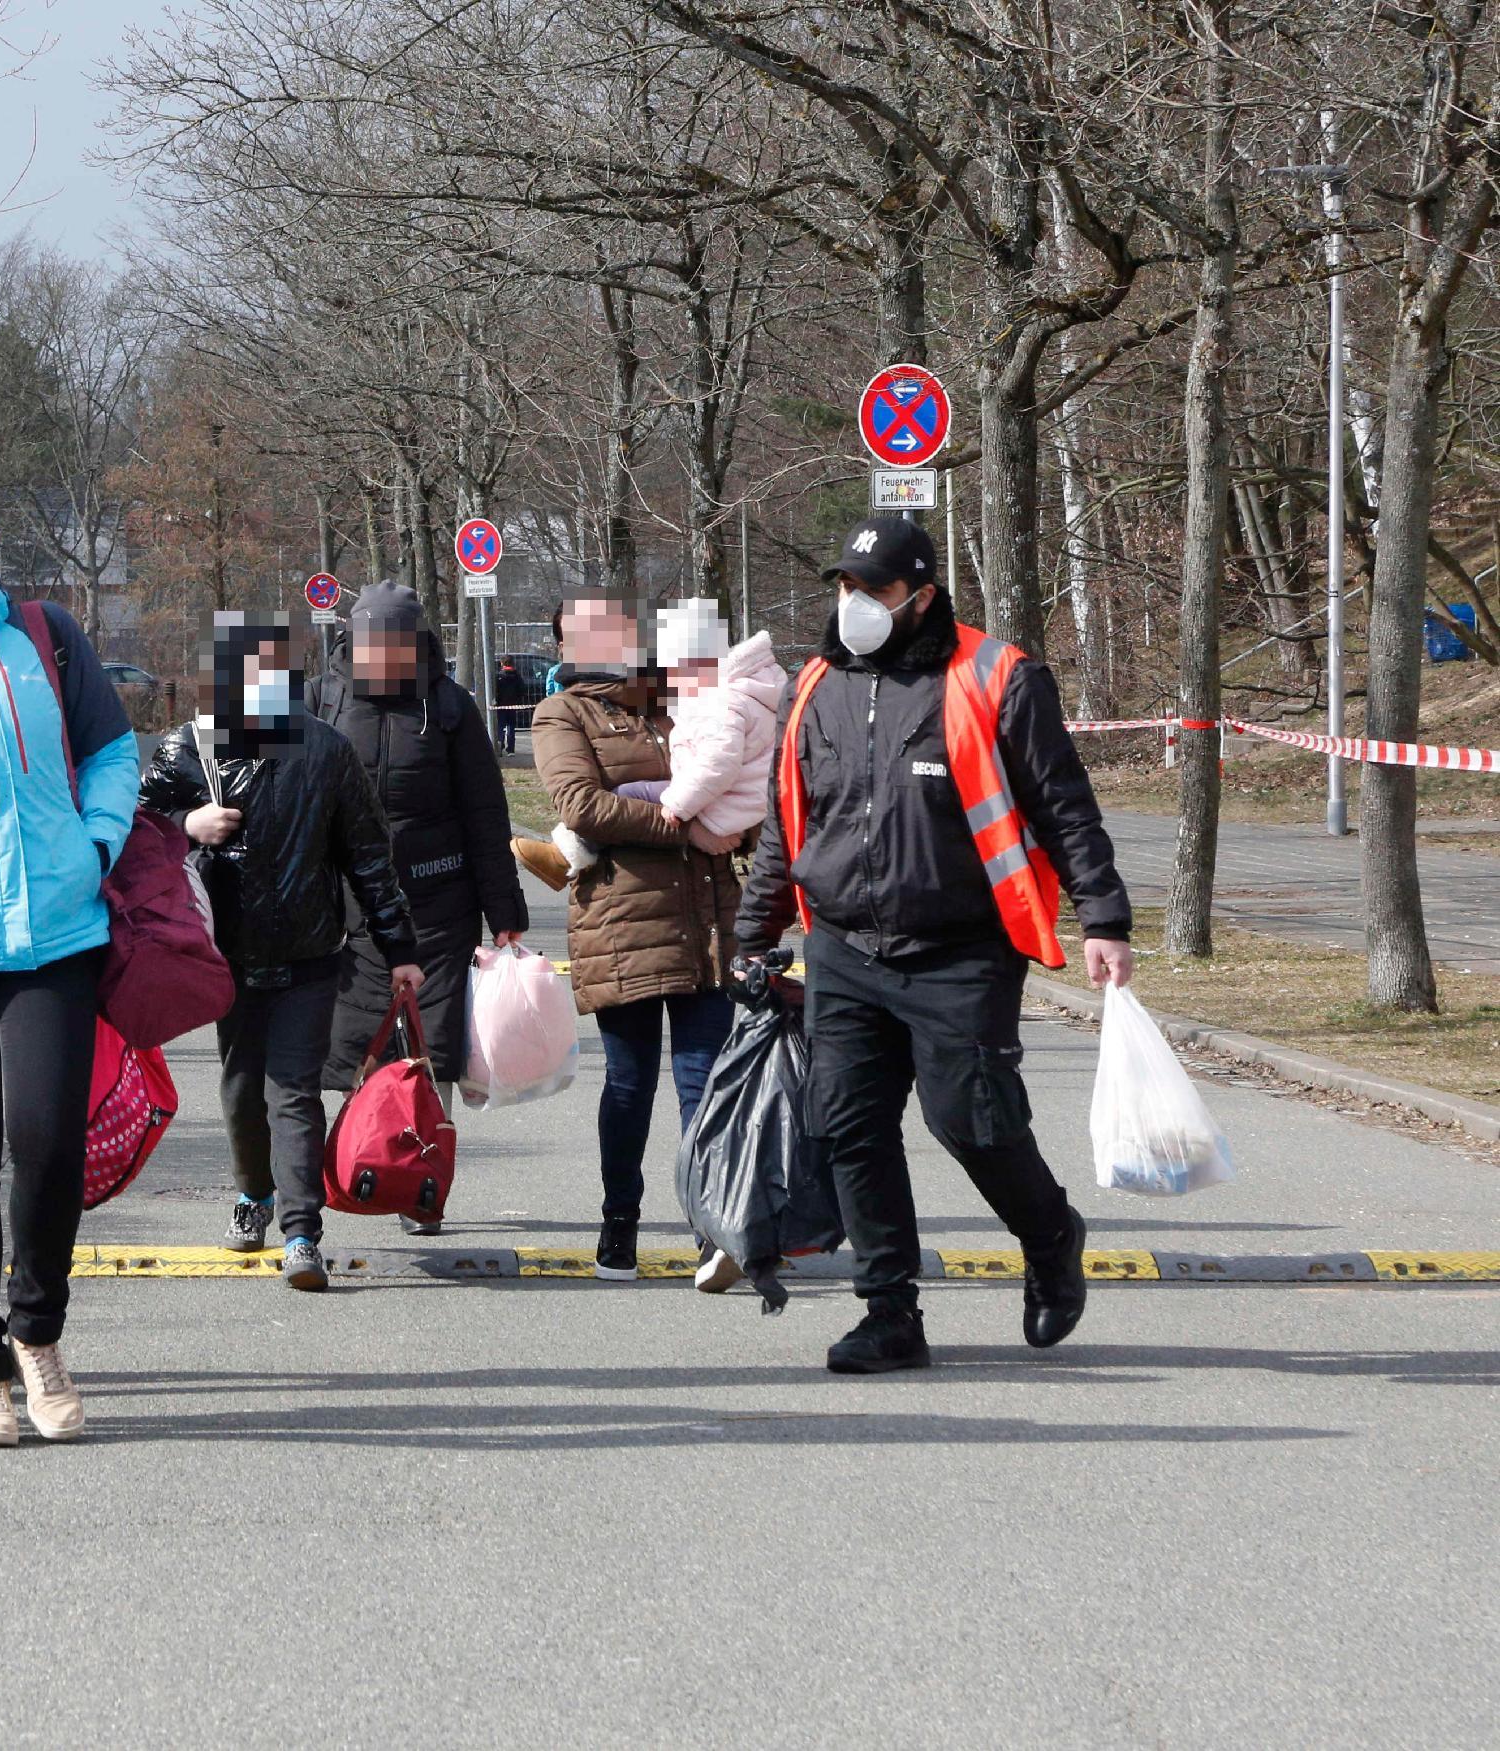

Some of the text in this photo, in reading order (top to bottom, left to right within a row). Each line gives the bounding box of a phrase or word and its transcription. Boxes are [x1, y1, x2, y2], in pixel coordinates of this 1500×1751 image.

[881, 476, 929, 487] Feuerwehr-
[911, 761, 947, 777] SECURI
[411, 853, 463, 878] YOURSELF
